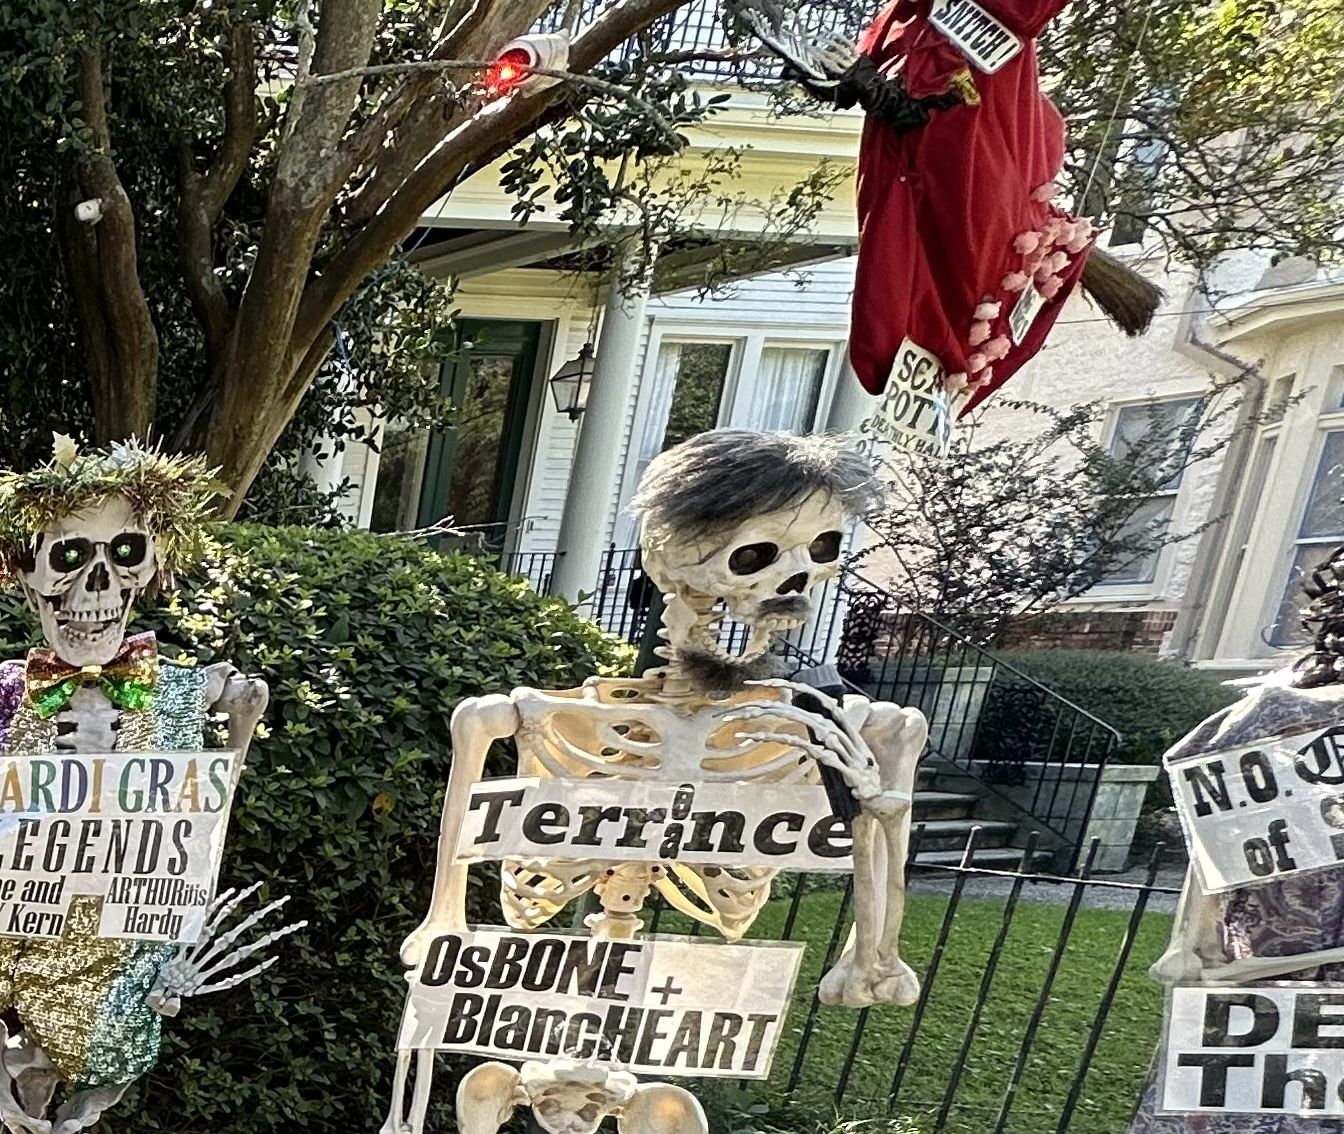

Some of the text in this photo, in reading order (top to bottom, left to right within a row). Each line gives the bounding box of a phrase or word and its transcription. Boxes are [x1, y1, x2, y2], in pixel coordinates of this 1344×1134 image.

[118, 757, 230, 814] GRAS
[1243, 819, 1297, 877] of
[21, 875, 67, 905] and
[7, 903, 66, 937] Kern
[123, 906, 185, 941] Hardy
[420, 934, 644, 1002] OsBONE
[442, 993, 778, 1073] BlancHEART
[1176, 1053, 1344, 1110] Th
